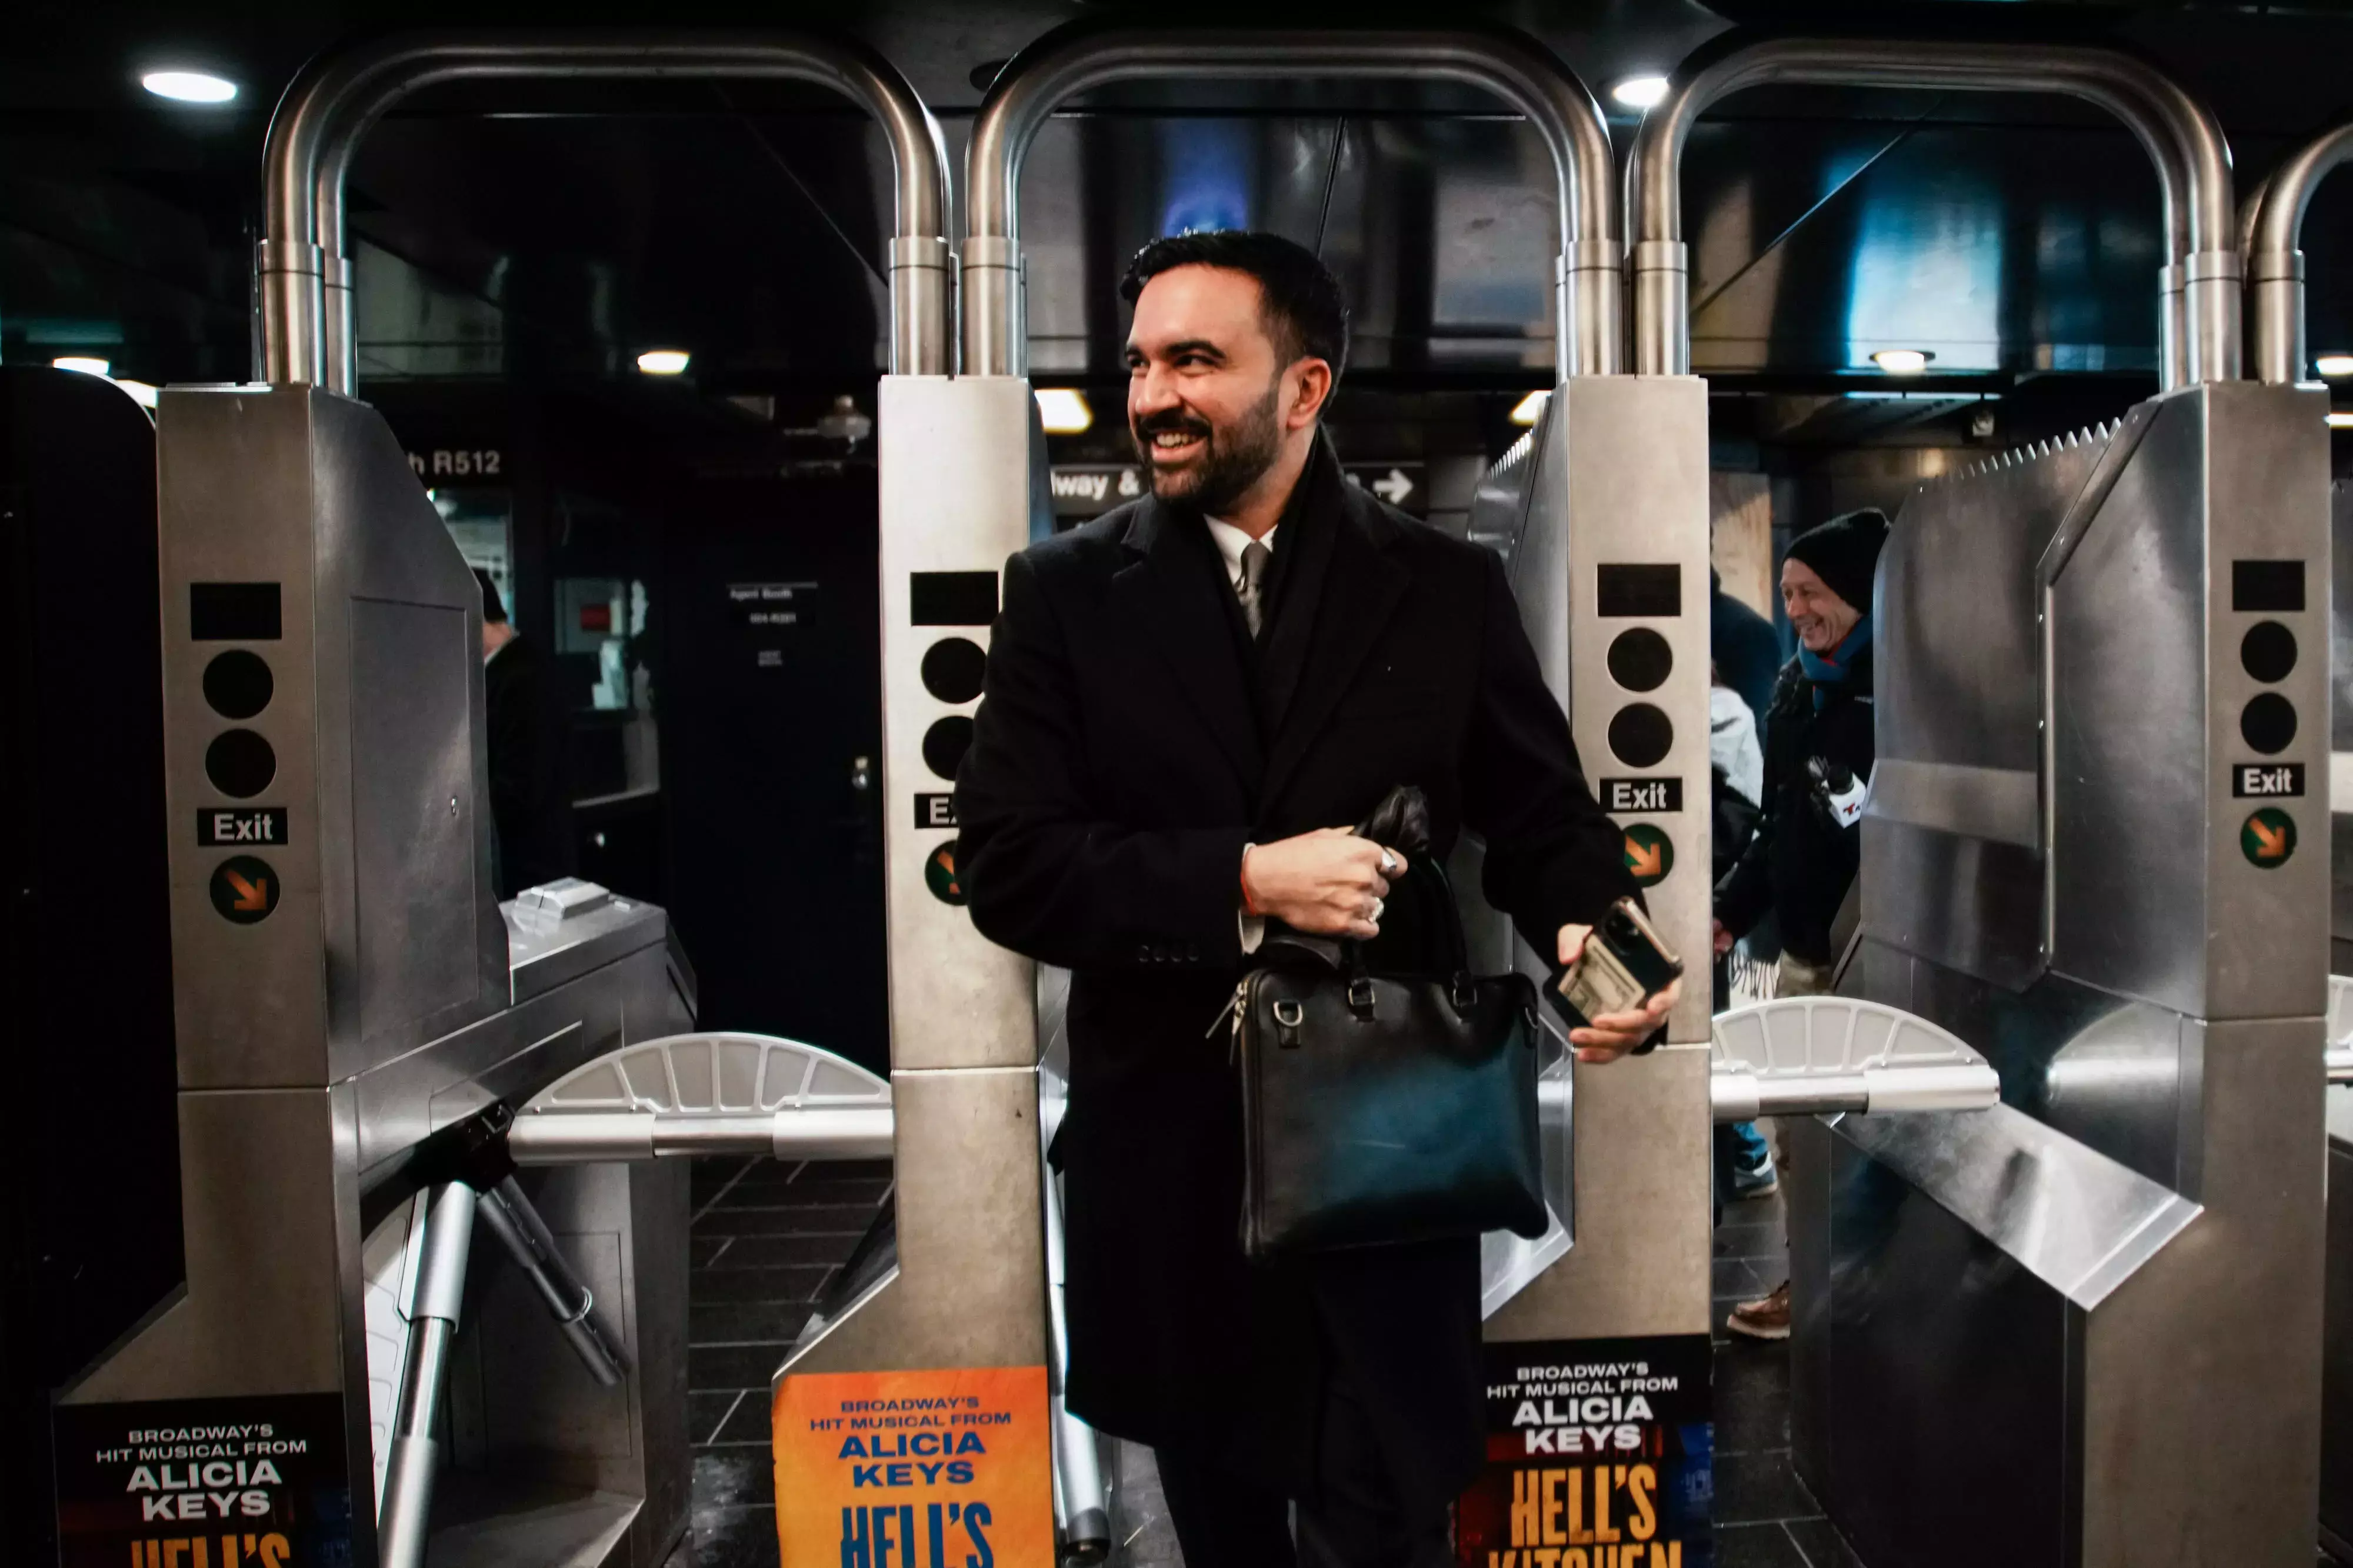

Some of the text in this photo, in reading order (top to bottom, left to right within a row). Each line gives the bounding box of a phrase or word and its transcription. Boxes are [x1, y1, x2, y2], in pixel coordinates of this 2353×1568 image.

[434, 449, 501, 476] R512
[1118, 469, 1139, 496] &
[2244, 767, 2292, 794] Exit
[1613, 782, 1667, 809] Exit
[214, 812, 274, 841] Exit
[1516, 1362, 1649, 1382] BROADWAY'S
[1487, 1376, 1678, 1399] HIT MUSICAL FROM
[841, 1397, 979, 1412] BROADWAY'S
[1512, 1395, 1654, 1427] ALICIA
[128, 1423, 274, 1444] BROADWAY'S
[810, 1412, 1011, 1431] HIT MUSICAL FROM
[96, 1439, 307, 1463] HIT MUSICAL FROM
[839, 1432, 986, 1459] ALICIA
[1525, 1423, 1641, 1454] KEYS
[126, 1459, 283, 1493] ALICIA
[853, 1461, 974, 1487] KEYS
[142, 1489, 271, 1522] KEYS
[1511, 1462, 1657, 1548] HELL'S
